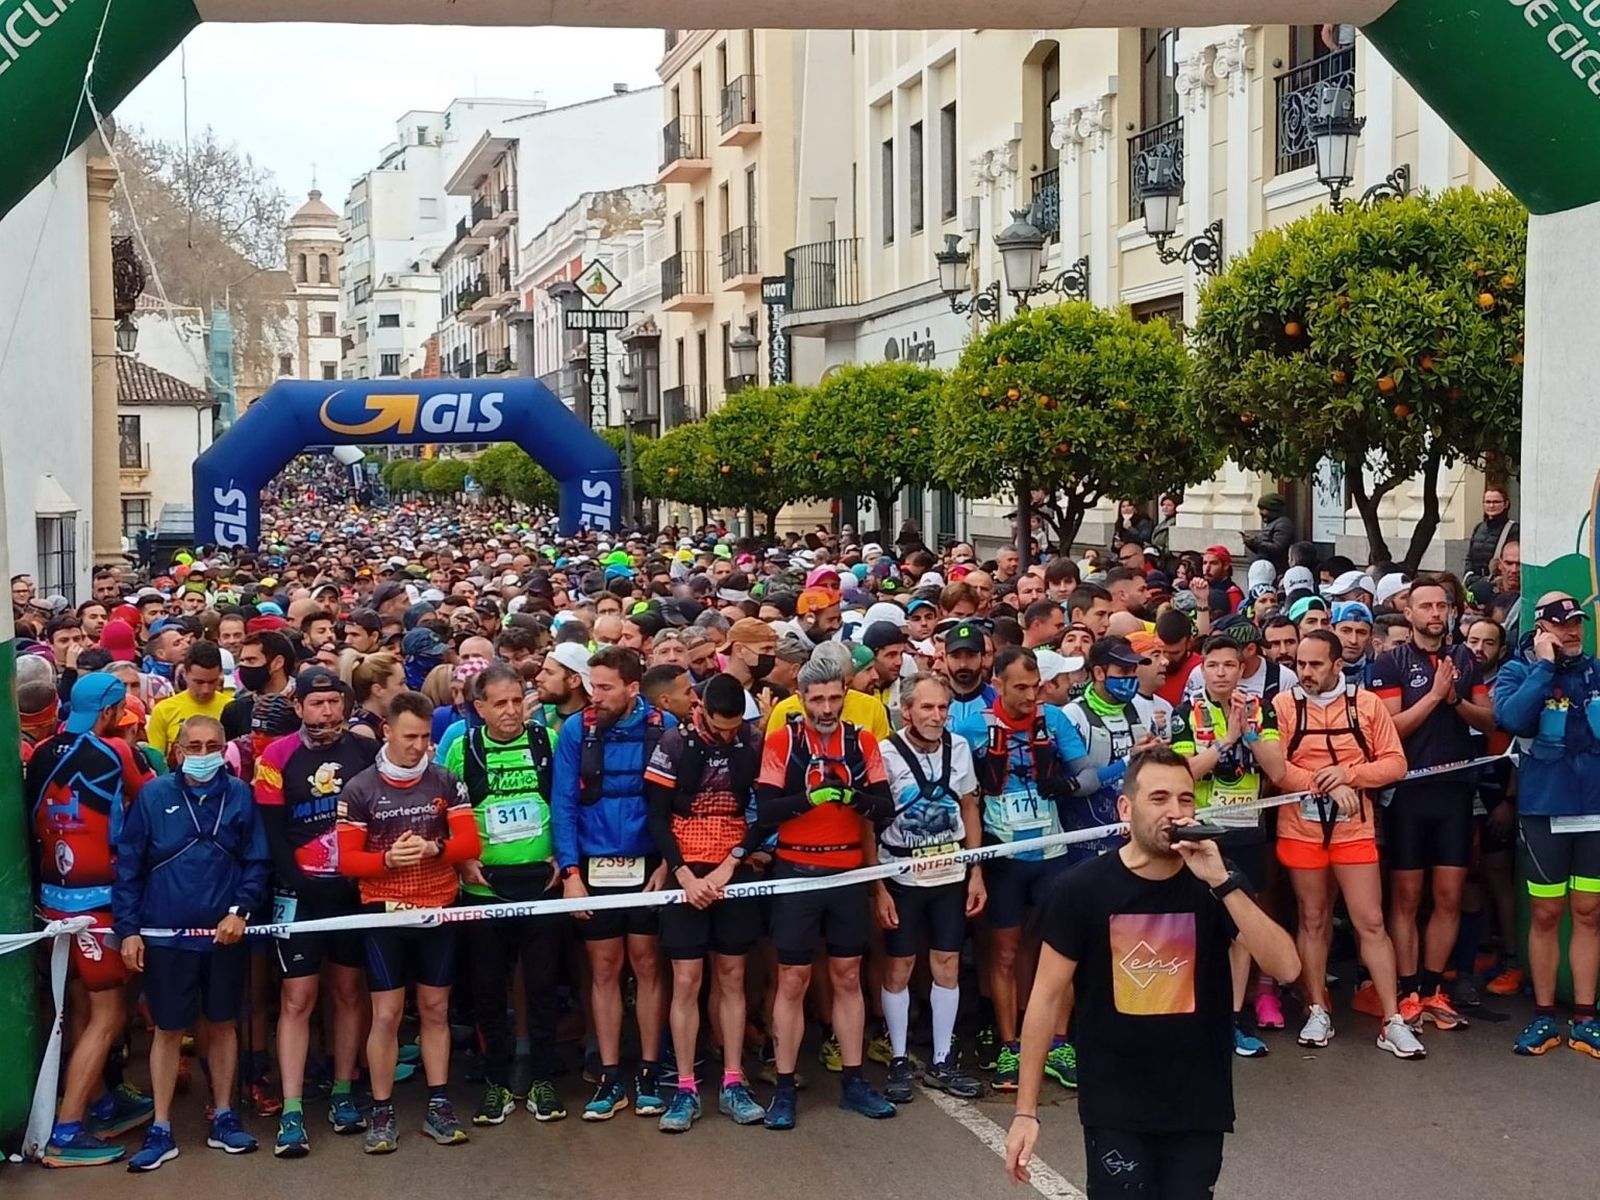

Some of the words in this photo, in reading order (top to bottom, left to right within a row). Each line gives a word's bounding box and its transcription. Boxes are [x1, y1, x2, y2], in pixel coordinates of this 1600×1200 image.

[420, 392, 504, 434] GLS
[213, 487, 247, 549] GLS
[498, 806, 527, 824] 311
